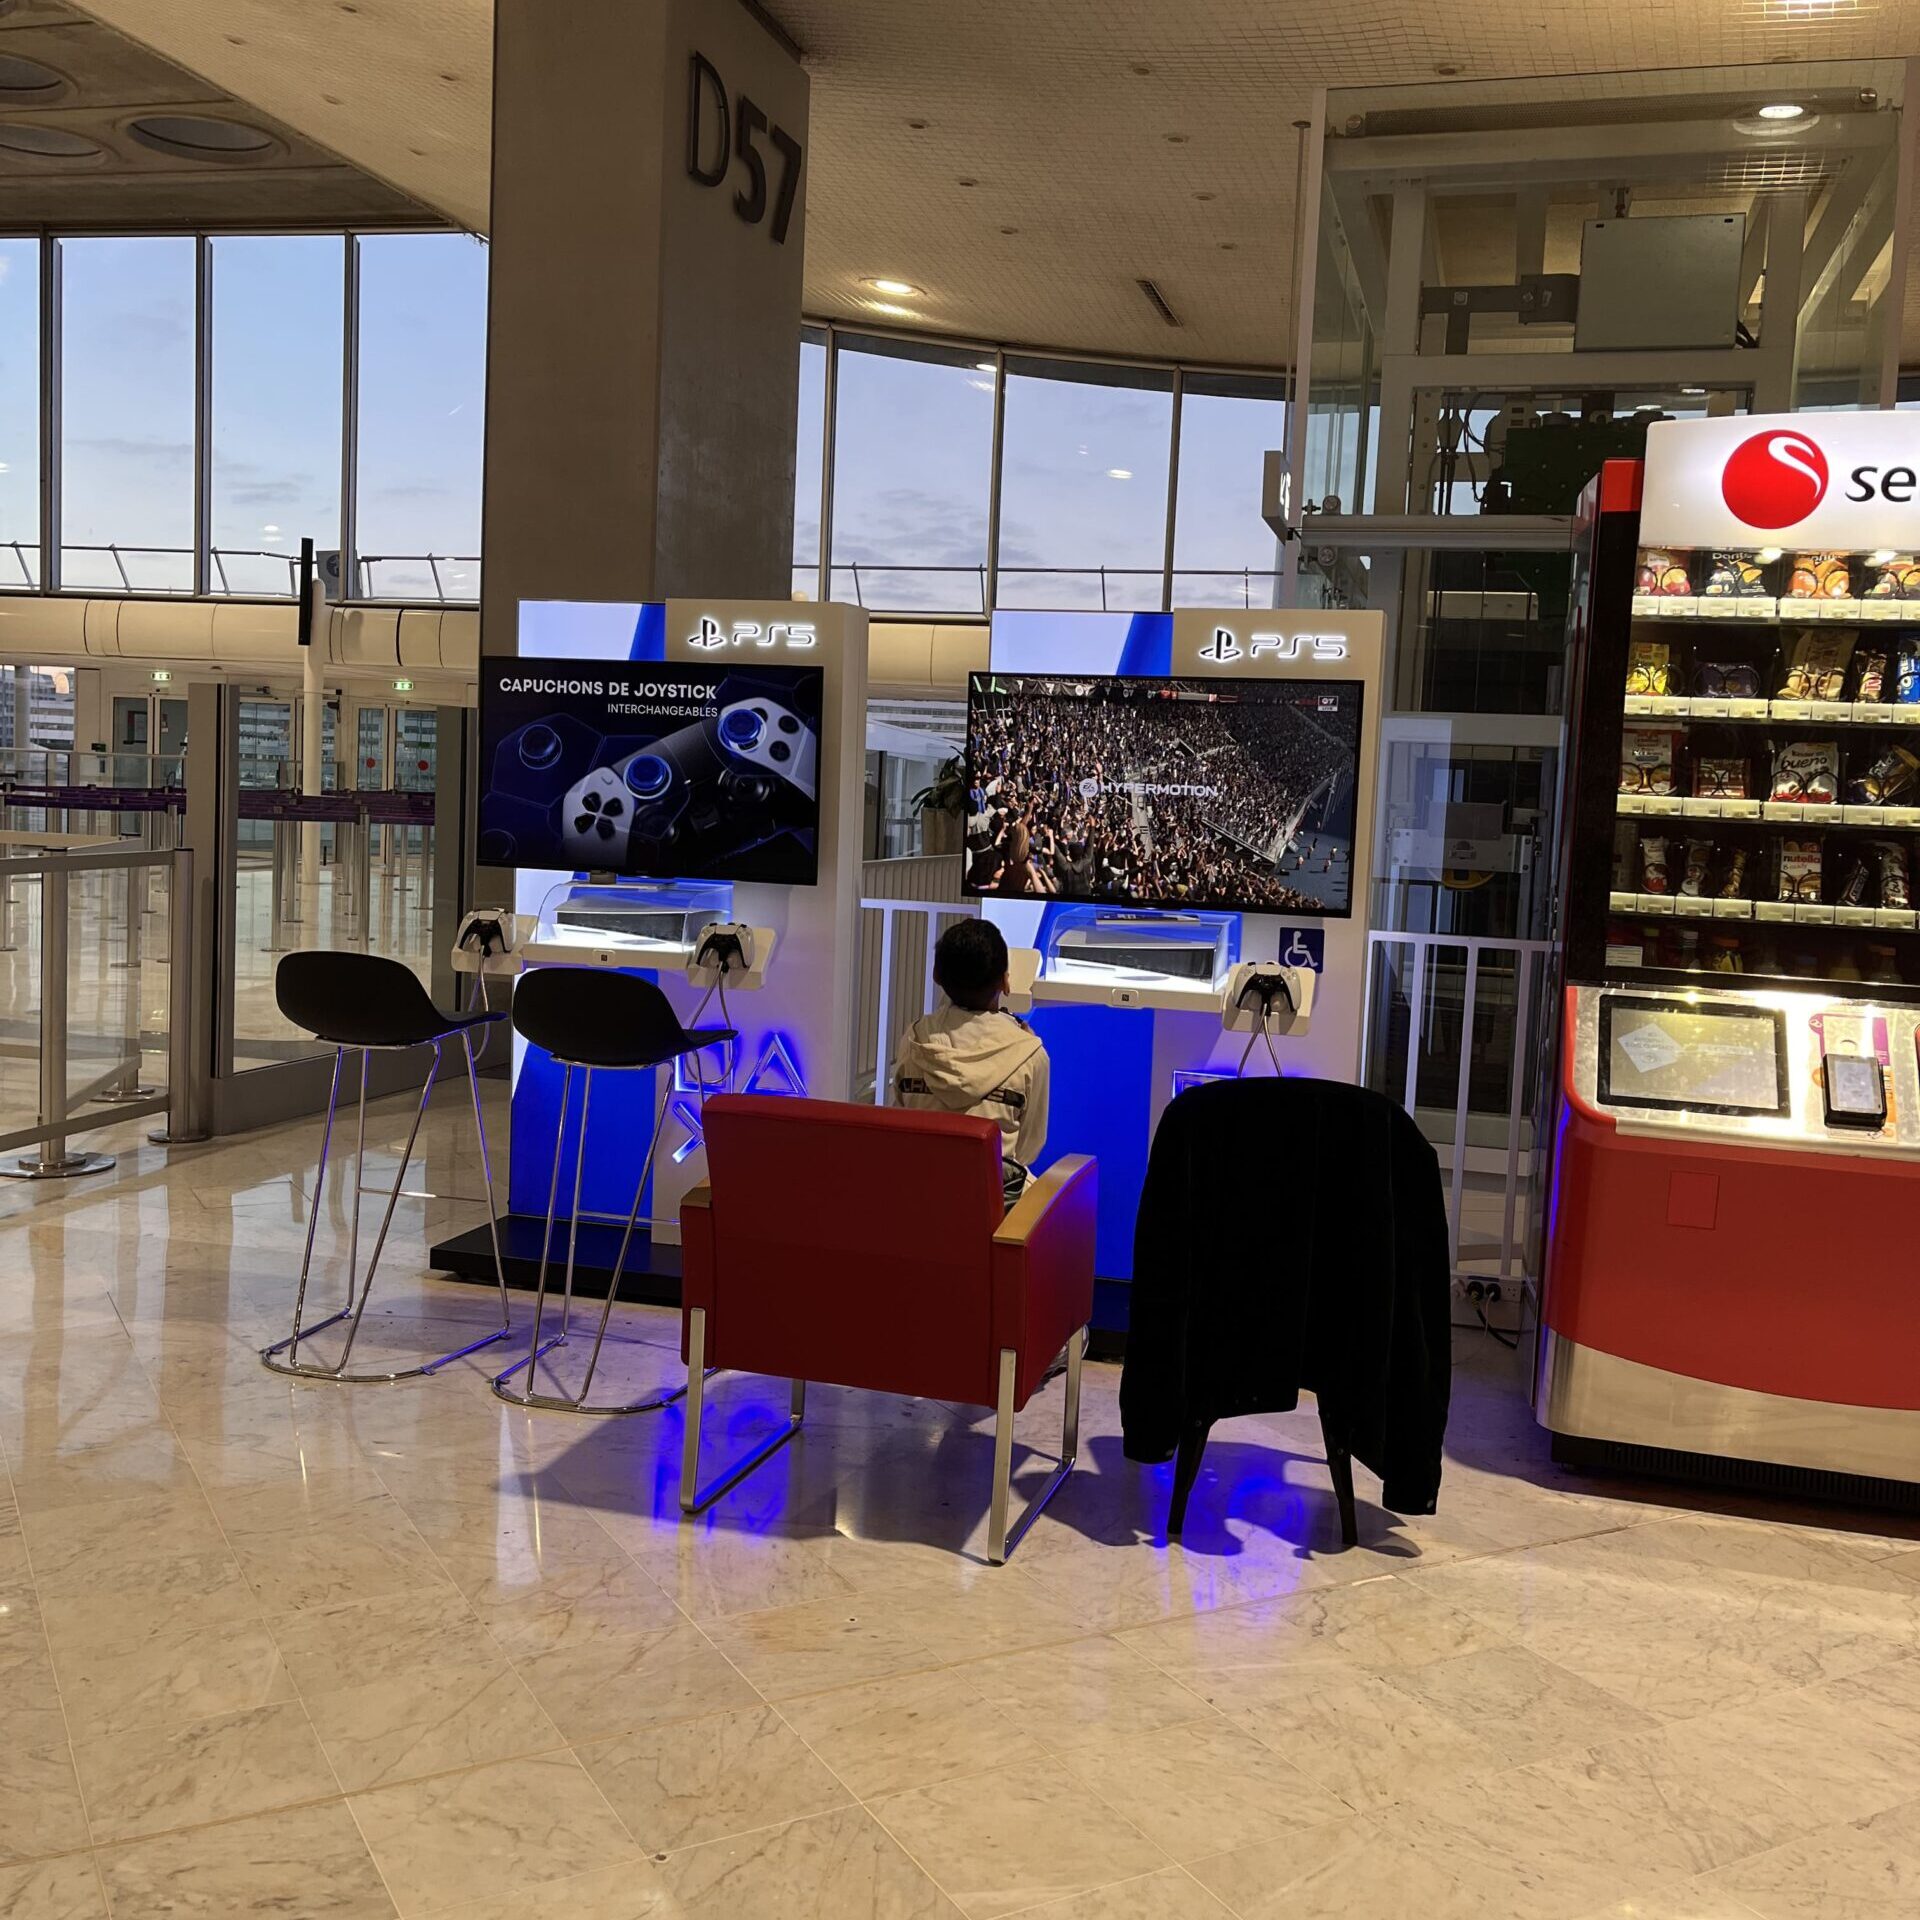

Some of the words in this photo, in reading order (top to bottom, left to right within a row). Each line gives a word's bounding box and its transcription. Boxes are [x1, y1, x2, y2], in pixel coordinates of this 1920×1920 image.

[688, 51, 802, 245] D57
[732, 623, 816, 647] PS5
[1250, 633, 1347, 660] PS5
[499, 677, 604, 695] CAPUCHONS
[608, 681, 629, 696] DE
[633, 682, 717, 700] JOYSTICK
[607, 703, 718, 718] INTERCHANGEABLES
[1781, 755, 1828, 770] bueno
[1101, 781, 1218, 797] HYPERMOTION
[1783, 854, 1821, 864] nutella
